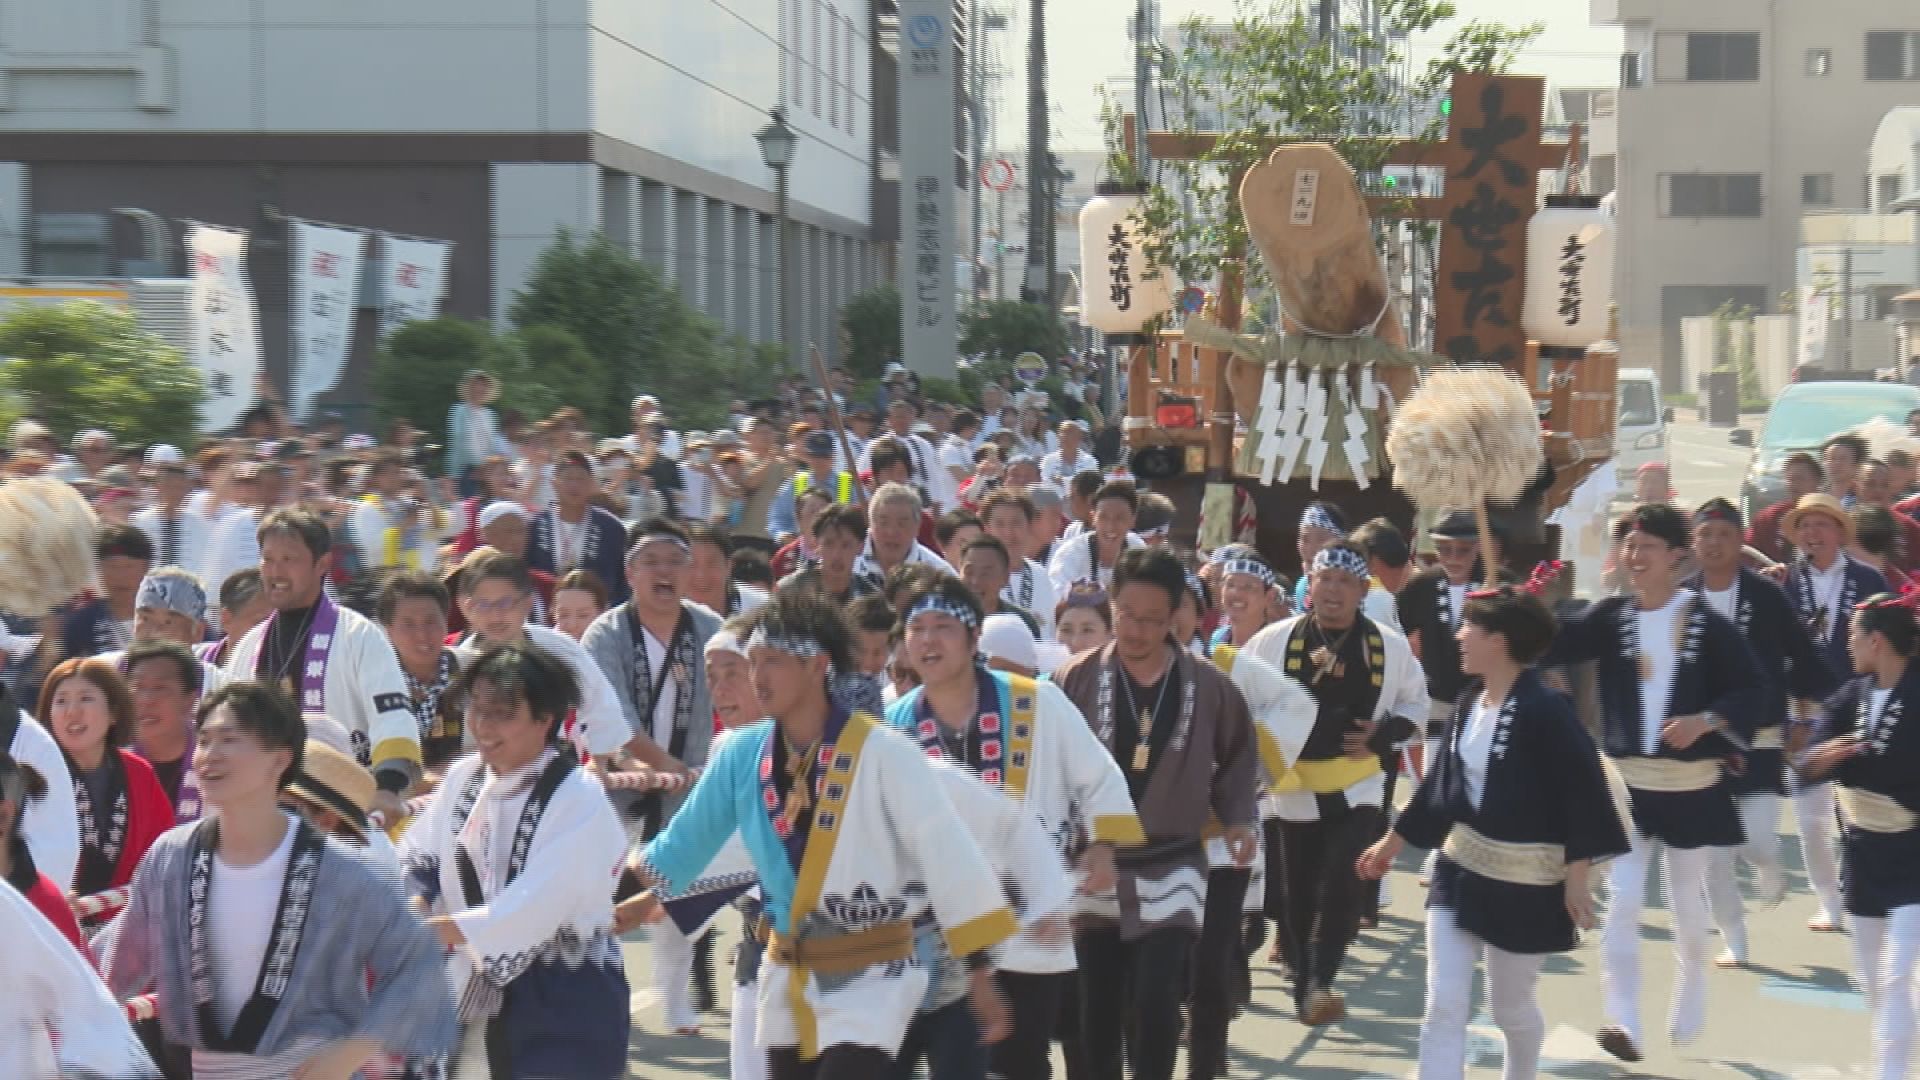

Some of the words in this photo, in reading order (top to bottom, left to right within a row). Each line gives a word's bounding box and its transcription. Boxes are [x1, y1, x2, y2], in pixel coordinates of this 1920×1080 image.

[914, 175, 941, 328] 伊勢志摩ビル
[1107, 222, 1133, 311] 大世古町
[1558, 234, 1587, 326] 大世古町
[260, 848, 321, 1002] 大世古青年団
